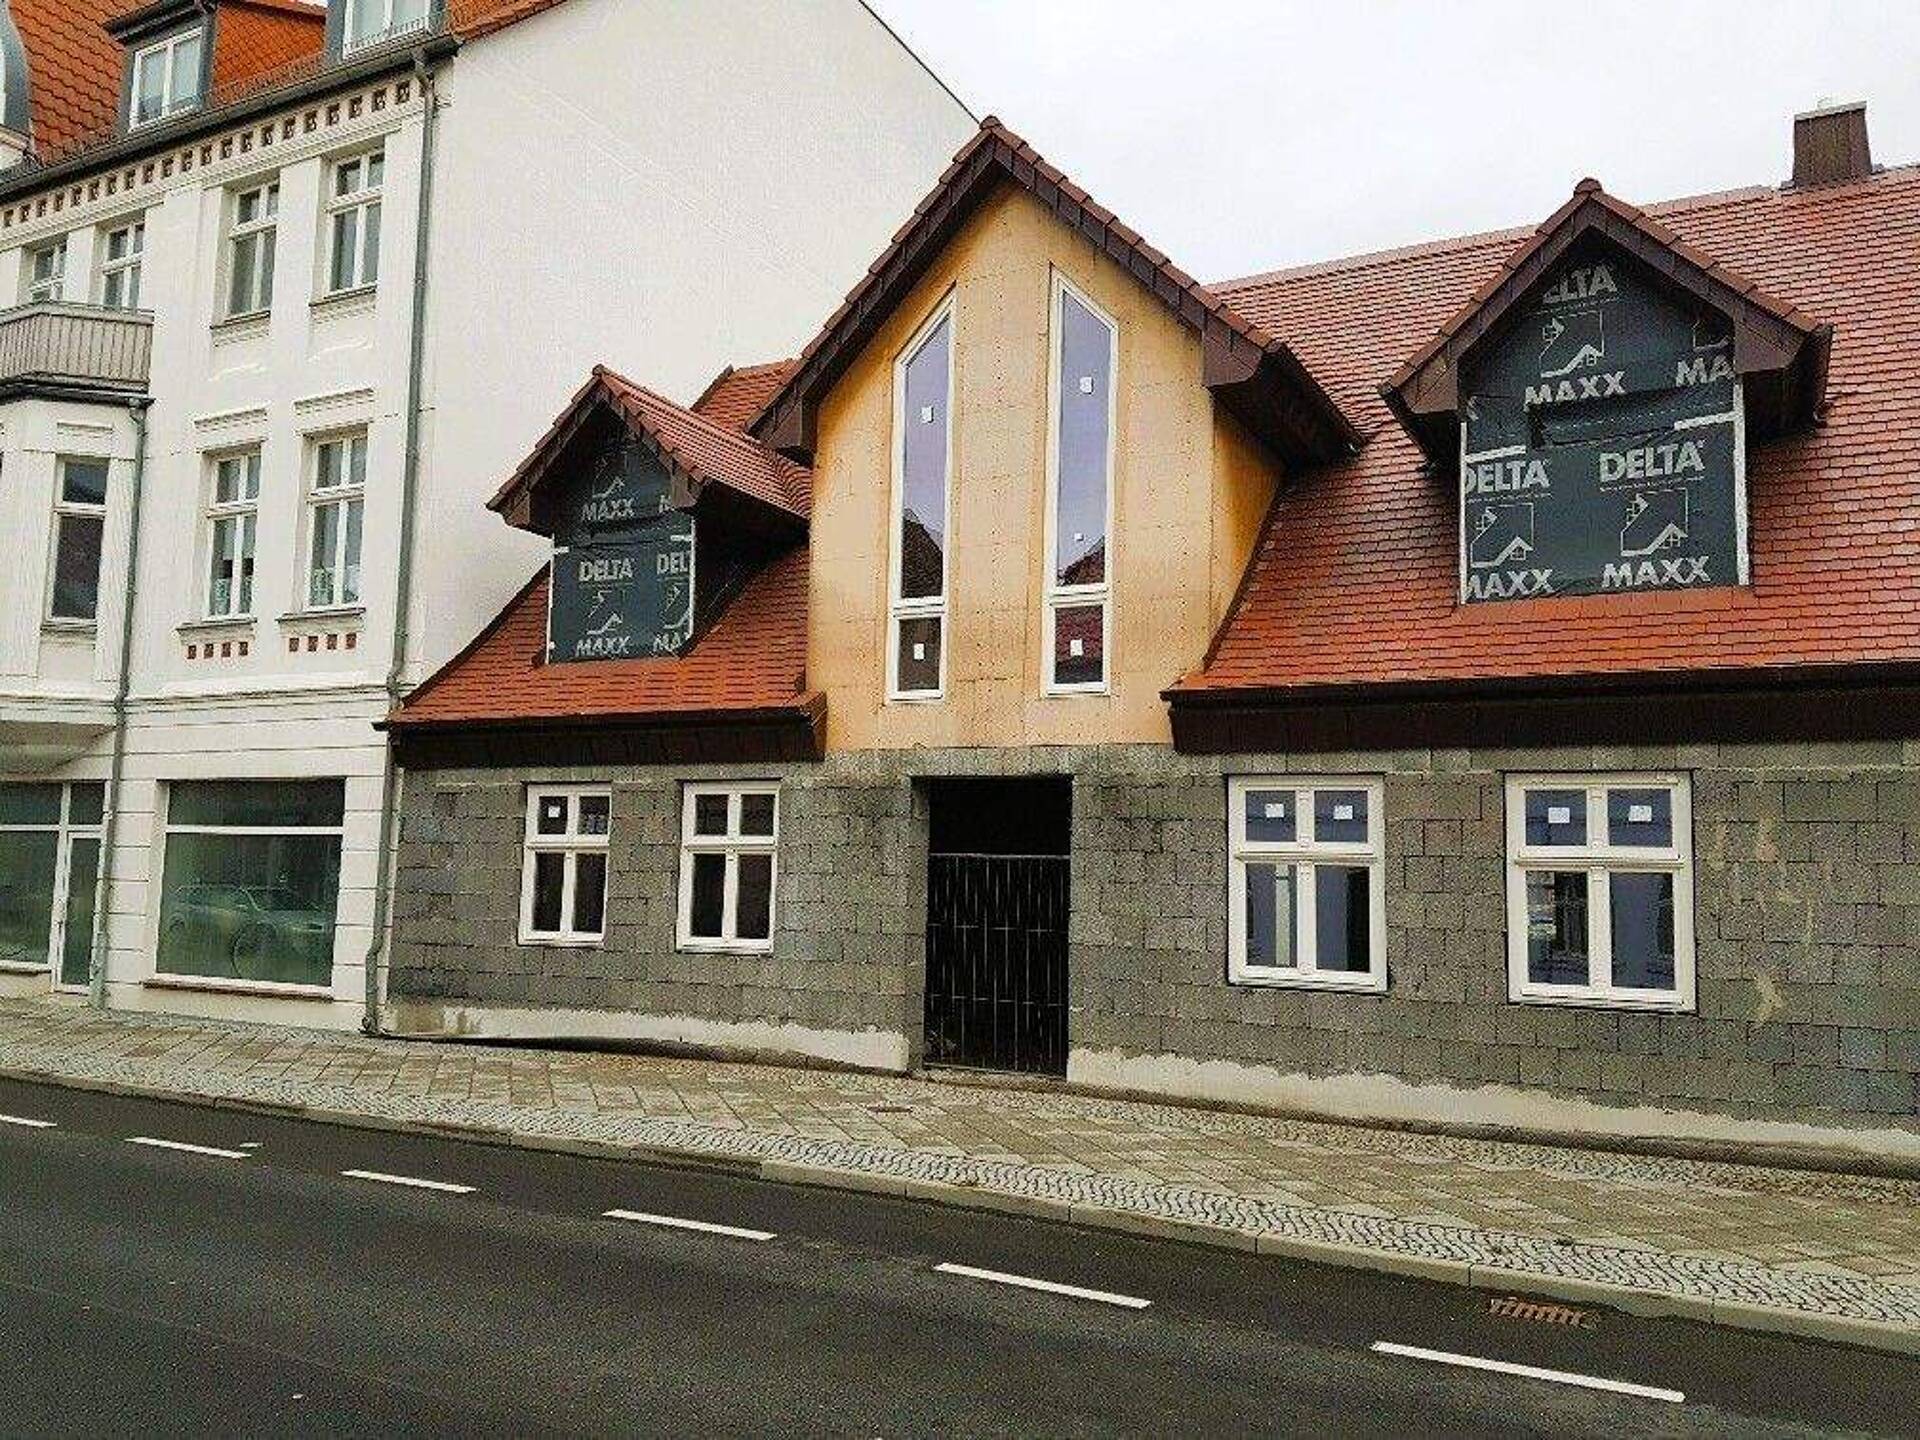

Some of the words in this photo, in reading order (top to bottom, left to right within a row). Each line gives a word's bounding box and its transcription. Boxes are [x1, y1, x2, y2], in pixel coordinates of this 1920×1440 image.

[1523, 370, 1626, 412] MAXX
[1599, 441, 1706, 483] DELTA
[579, 559, 634, 582] DELTA
[1602, 555, 1711, 589] MAXX
[575, 635, 633, 656] MAXX
